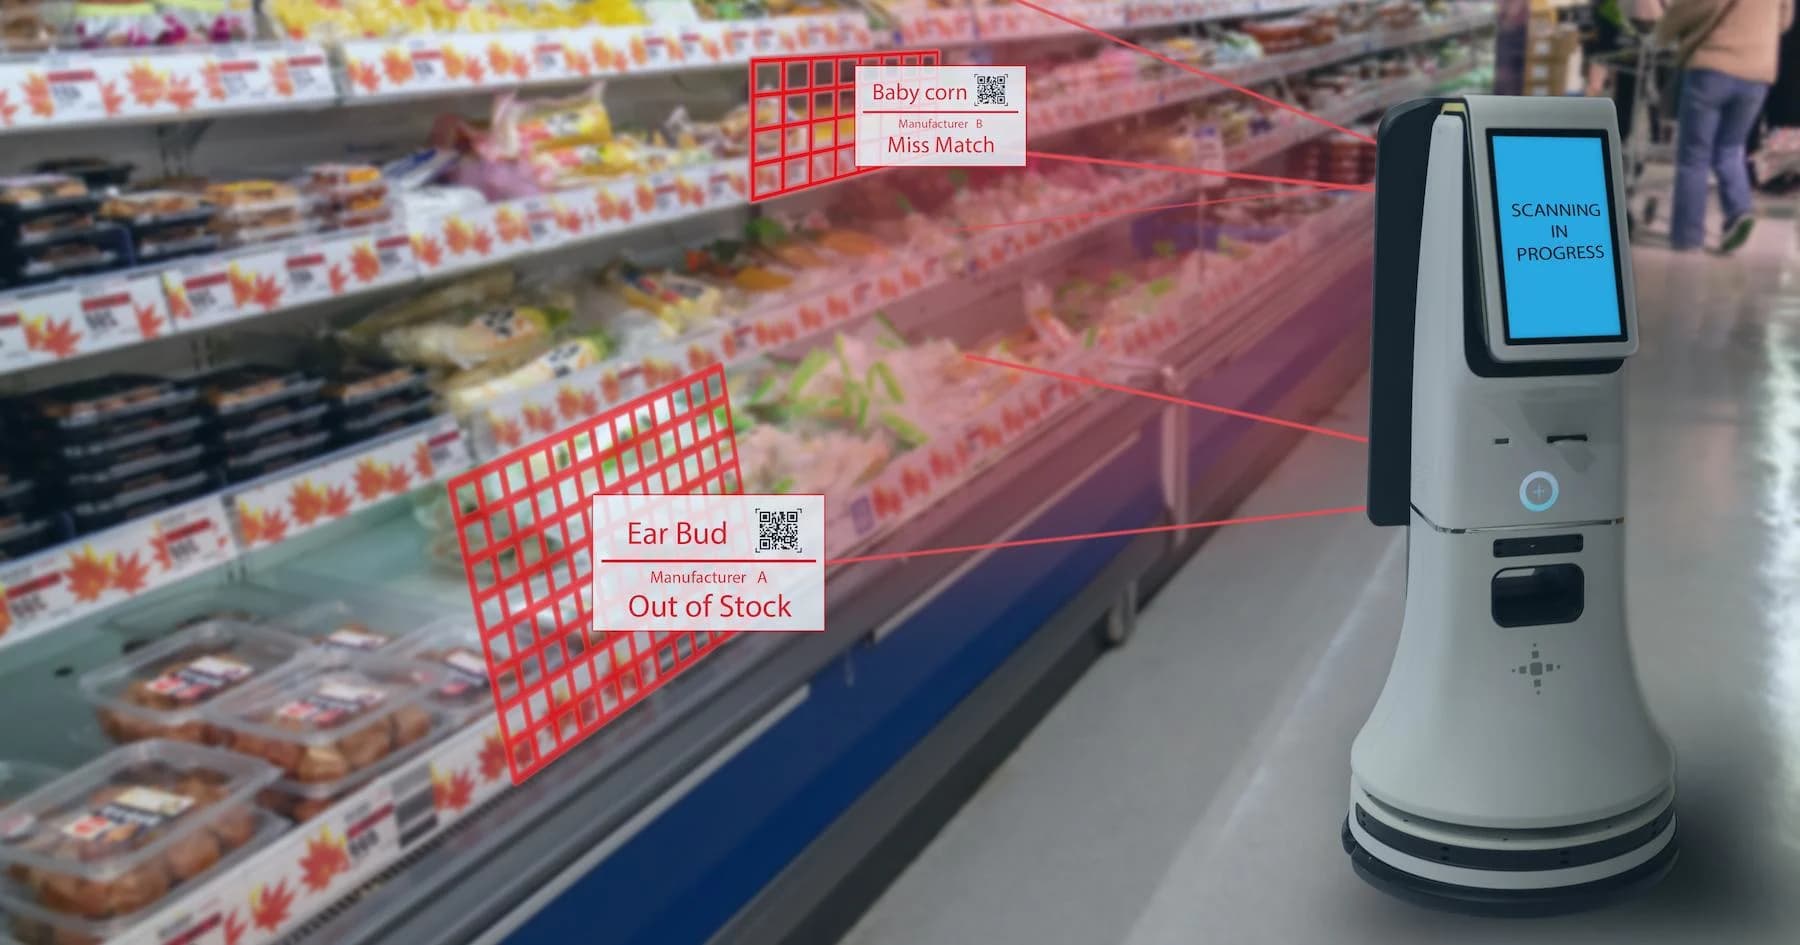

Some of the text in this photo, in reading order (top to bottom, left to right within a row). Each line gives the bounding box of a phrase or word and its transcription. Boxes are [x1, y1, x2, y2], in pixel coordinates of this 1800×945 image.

[1511, 203, 1601, 217] SCANNING
[1551, 225, 1568, 238] IN
[1517, 245, 1605, 262] PROGRESS
